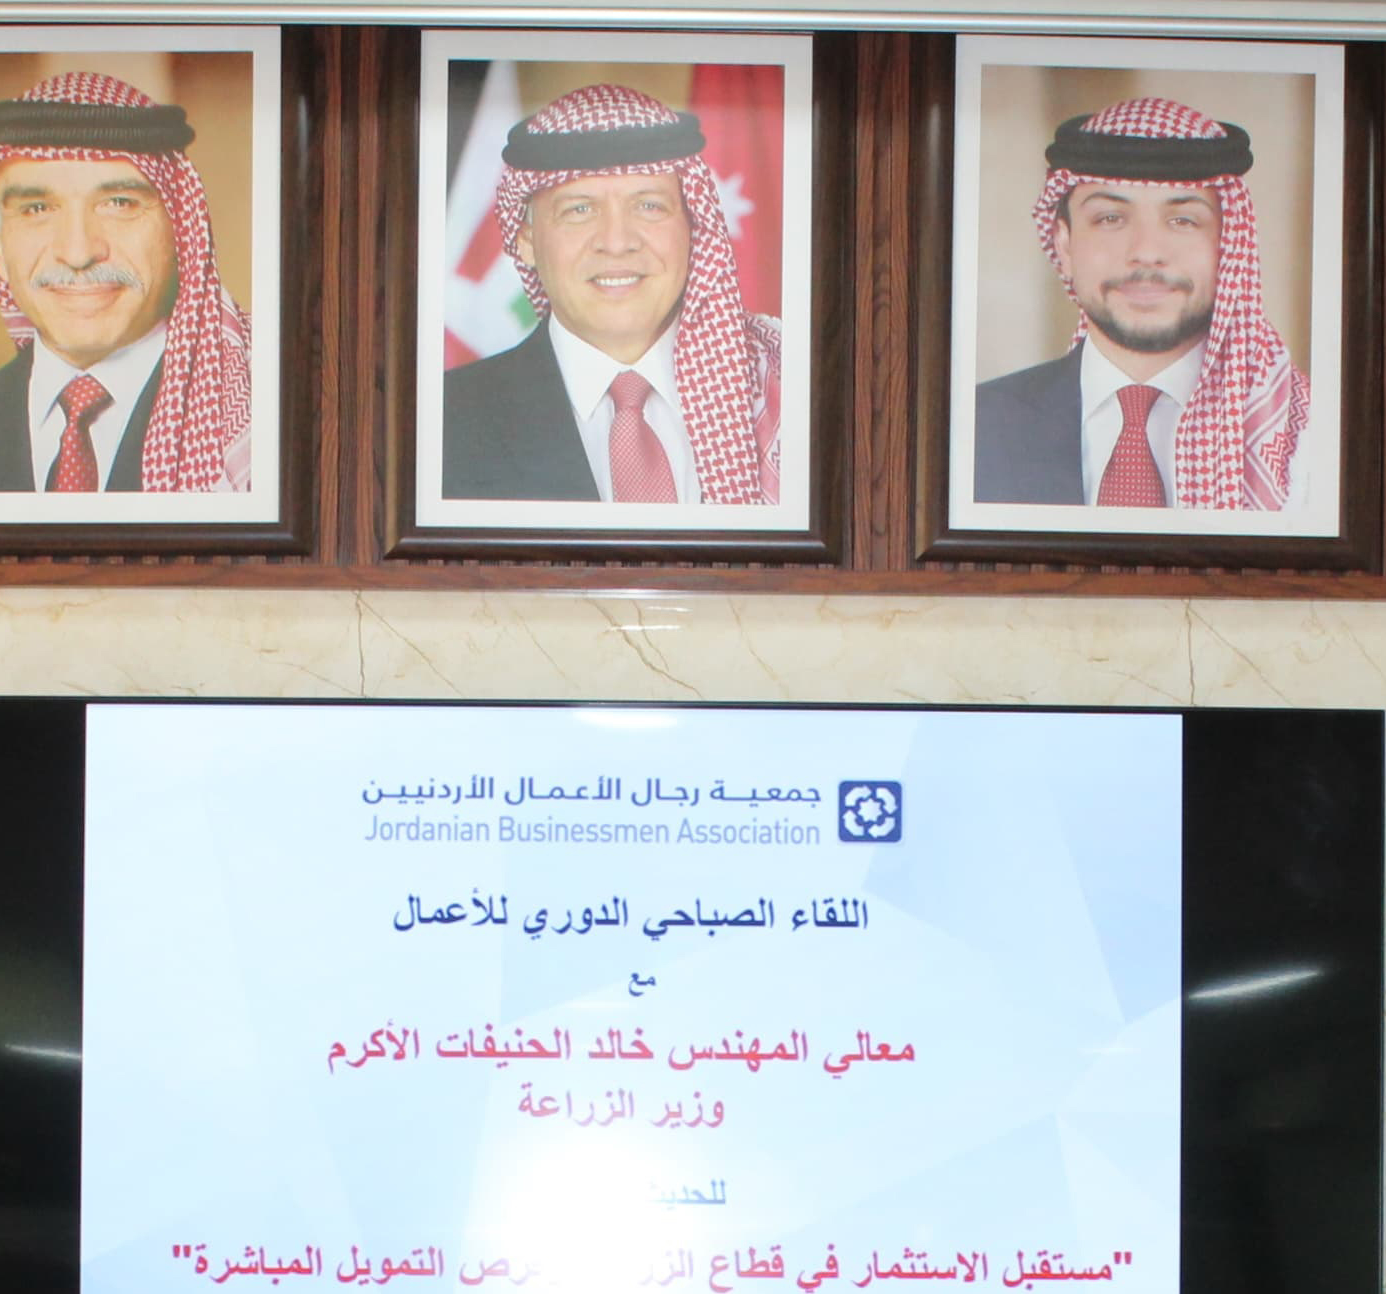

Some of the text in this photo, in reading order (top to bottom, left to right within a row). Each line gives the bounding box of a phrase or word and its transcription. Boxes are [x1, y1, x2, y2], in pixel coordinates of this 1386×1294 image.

[361, 773, 821, 807] جمعية رجال الأعمال الأردنيين
[365, 813, 821, 845] Jordanian Businessmen Association
[393, 887, 869, 941] اللقاء الصباحي الدوري للأعمال
[627, 971, 658, 997] مع
[326, 1018, 916, 1080] معالي المهندس خالد الحنيفات الأكرم
[517, 1082, 725, 1130] وزير الزراعة
[336, 1245, 445, 1285] التمويل
[708, 1244, 785, 1293] قطاع
[796, 1243, 840, 1293] في
[851, 1247, 988, 1288] الاستثمار
